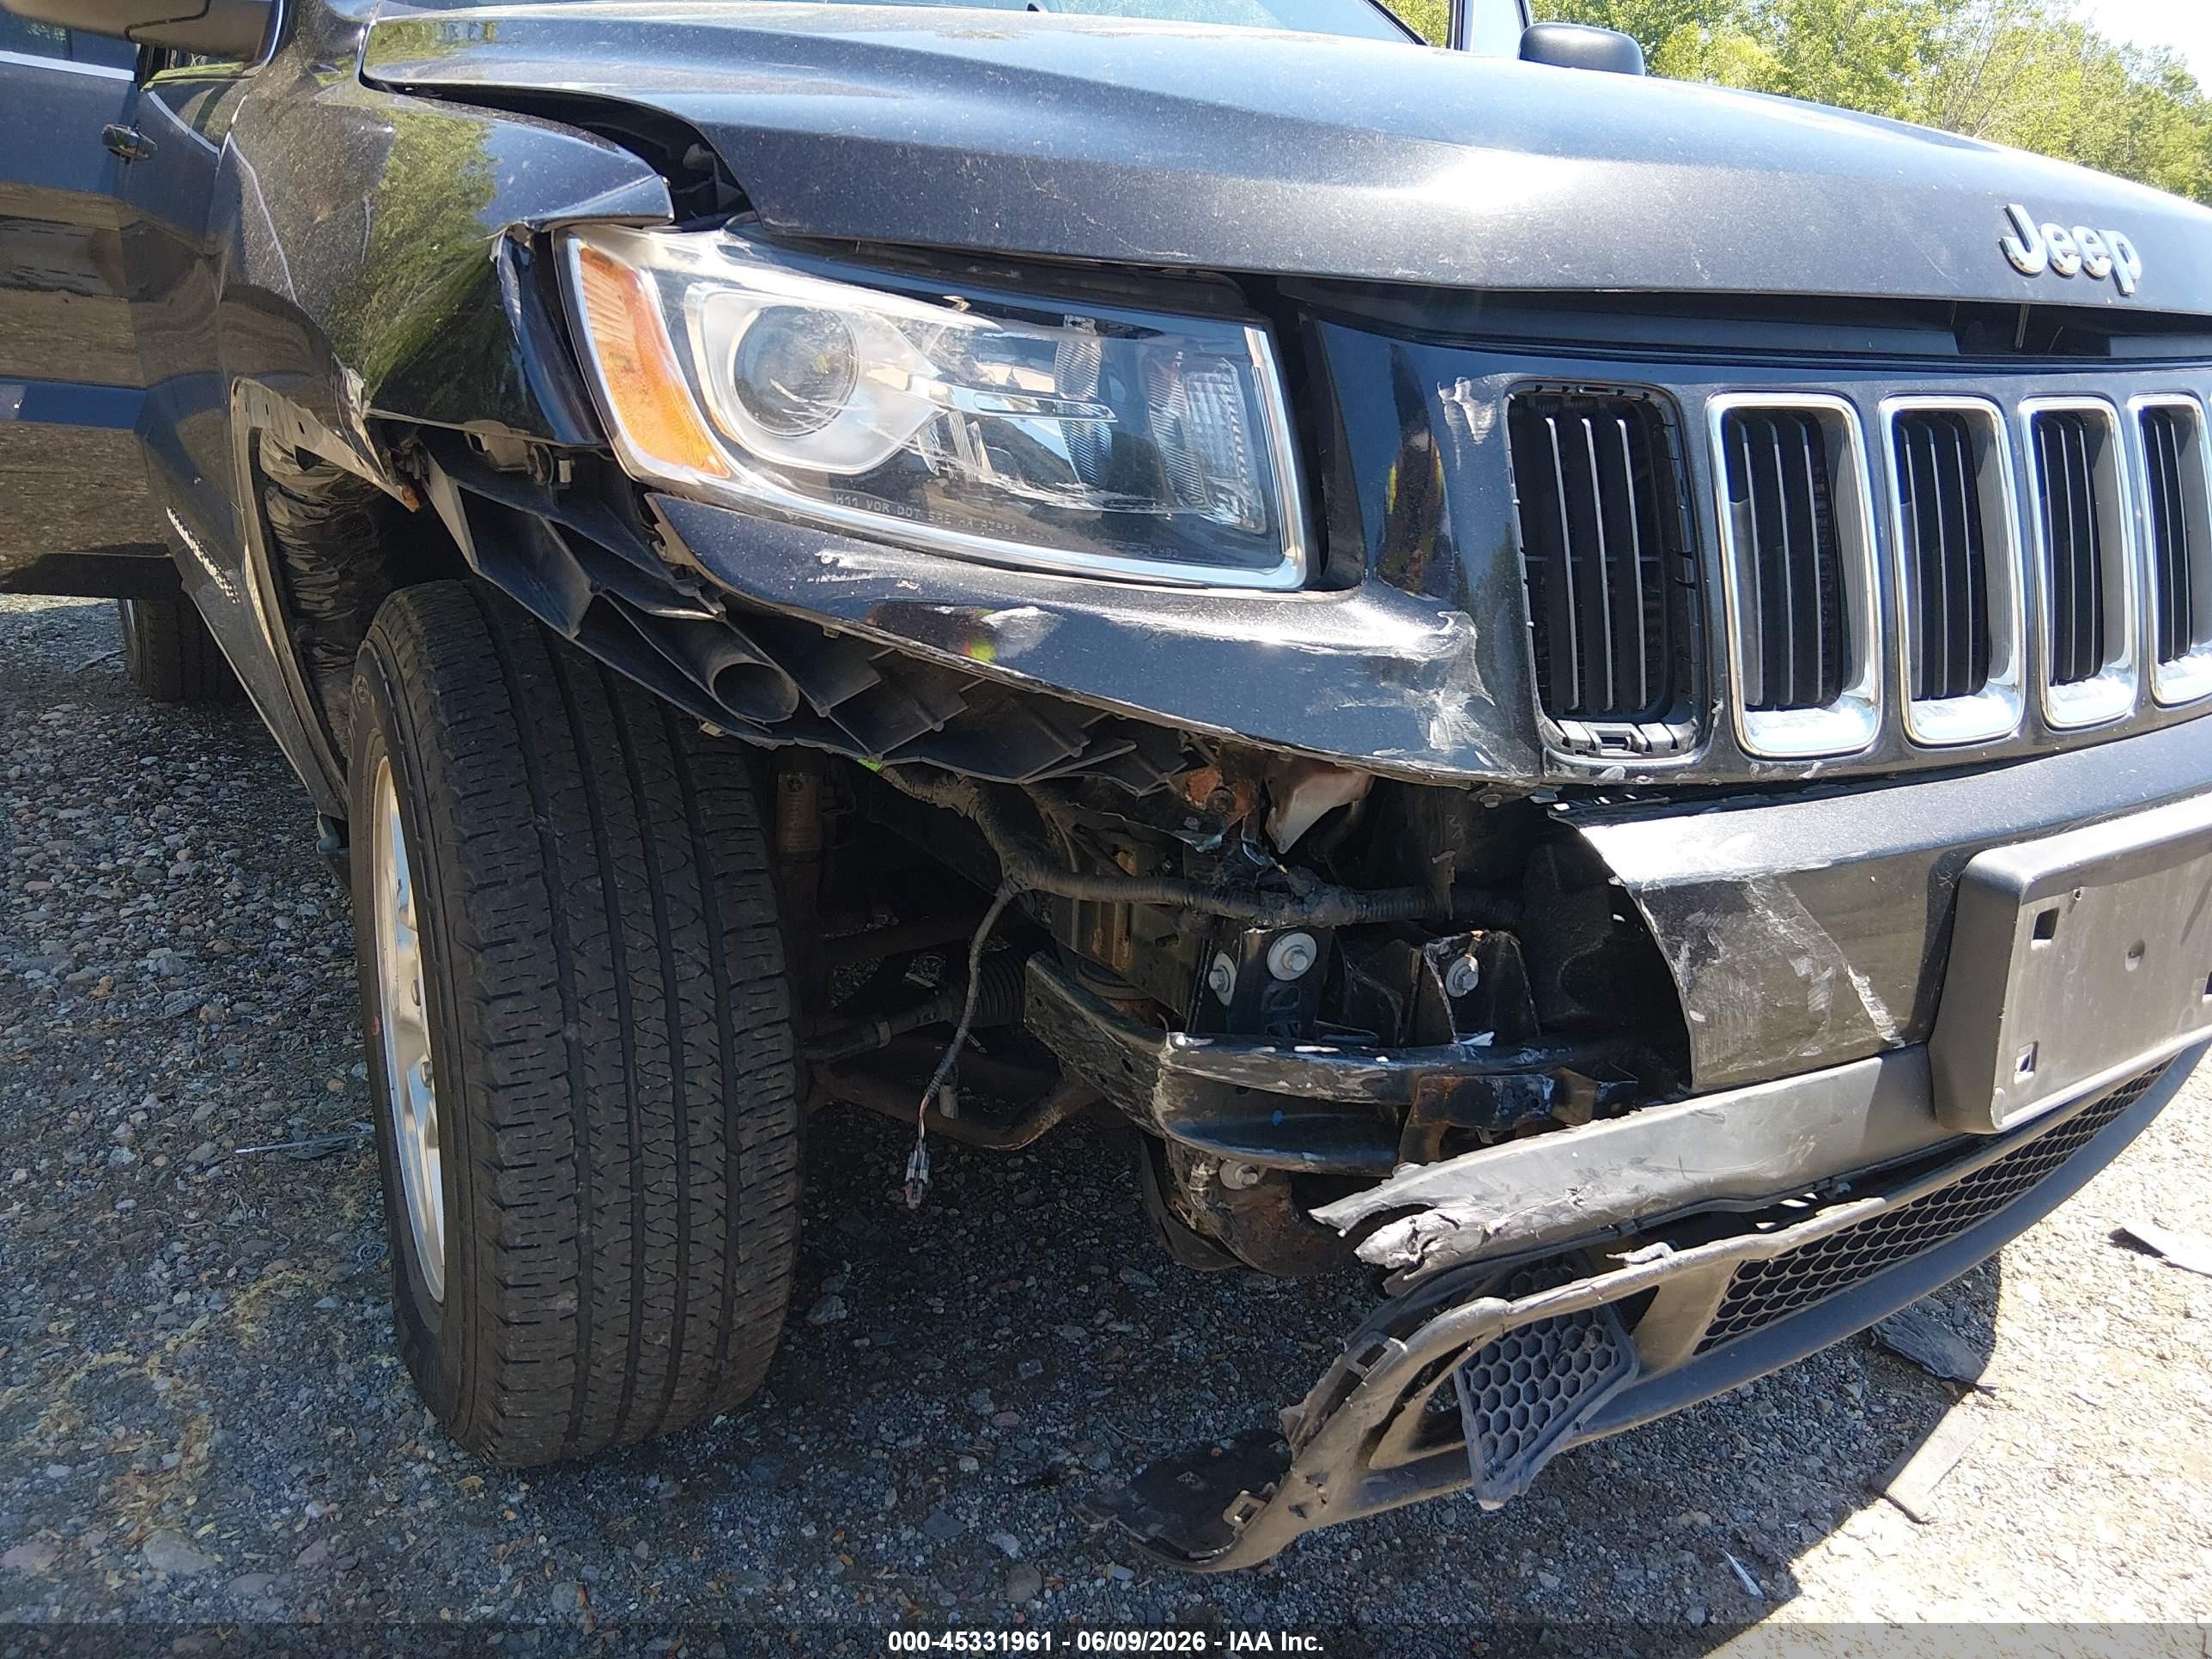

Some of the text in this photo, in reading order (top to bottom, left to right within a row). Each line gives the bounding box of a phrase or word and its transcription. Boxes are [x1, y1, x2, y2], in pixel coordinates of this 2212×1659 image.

[2000, 203, 2142, 294] Jeep
[836, 493, 859, 507] H11
[866, 499, 890, 513] VOR
[897, 505, 921, 519] DOT
[928, 511, 951, 525] SAE
